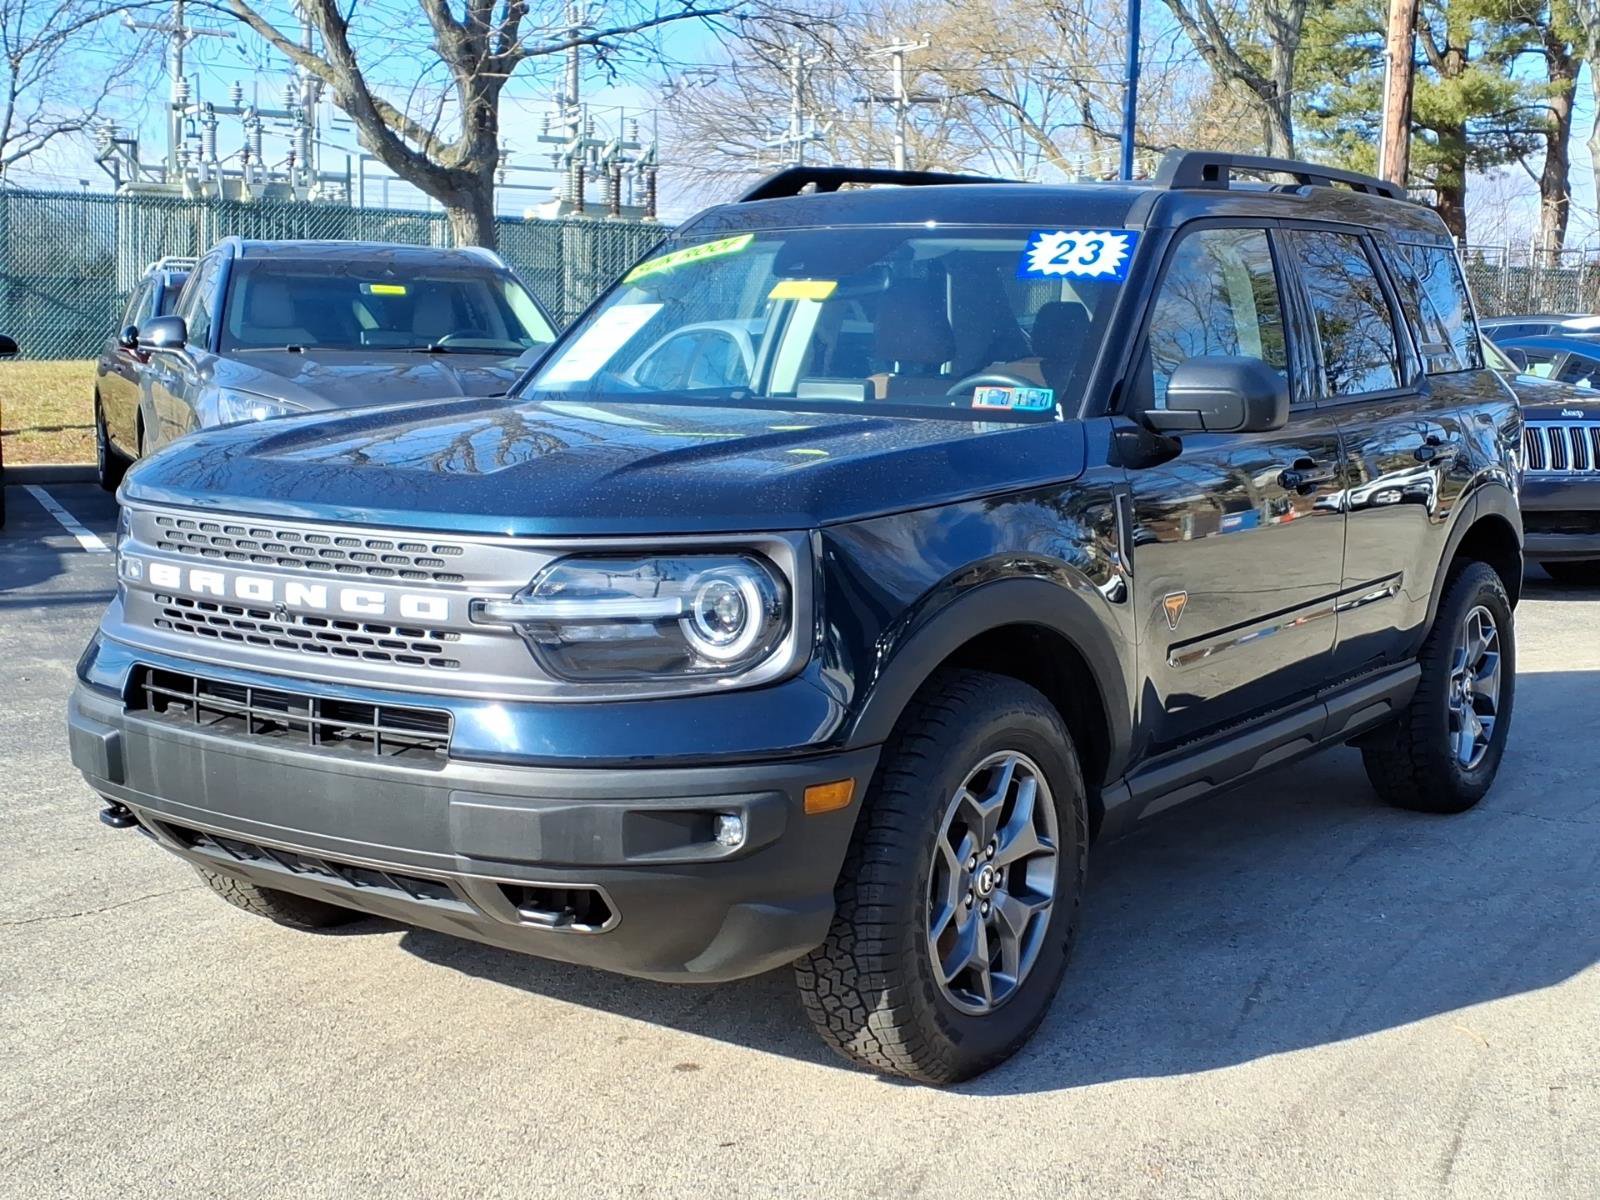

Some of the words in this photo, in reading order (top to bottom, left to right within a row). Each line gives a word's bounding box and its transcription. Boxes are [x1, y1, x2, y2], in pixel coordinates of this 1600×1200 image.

[1048, 239, 1105, 266] 23
[1561, 408, 1585, 419] Jeep
[149, 562, 449, 621] BRONCO
